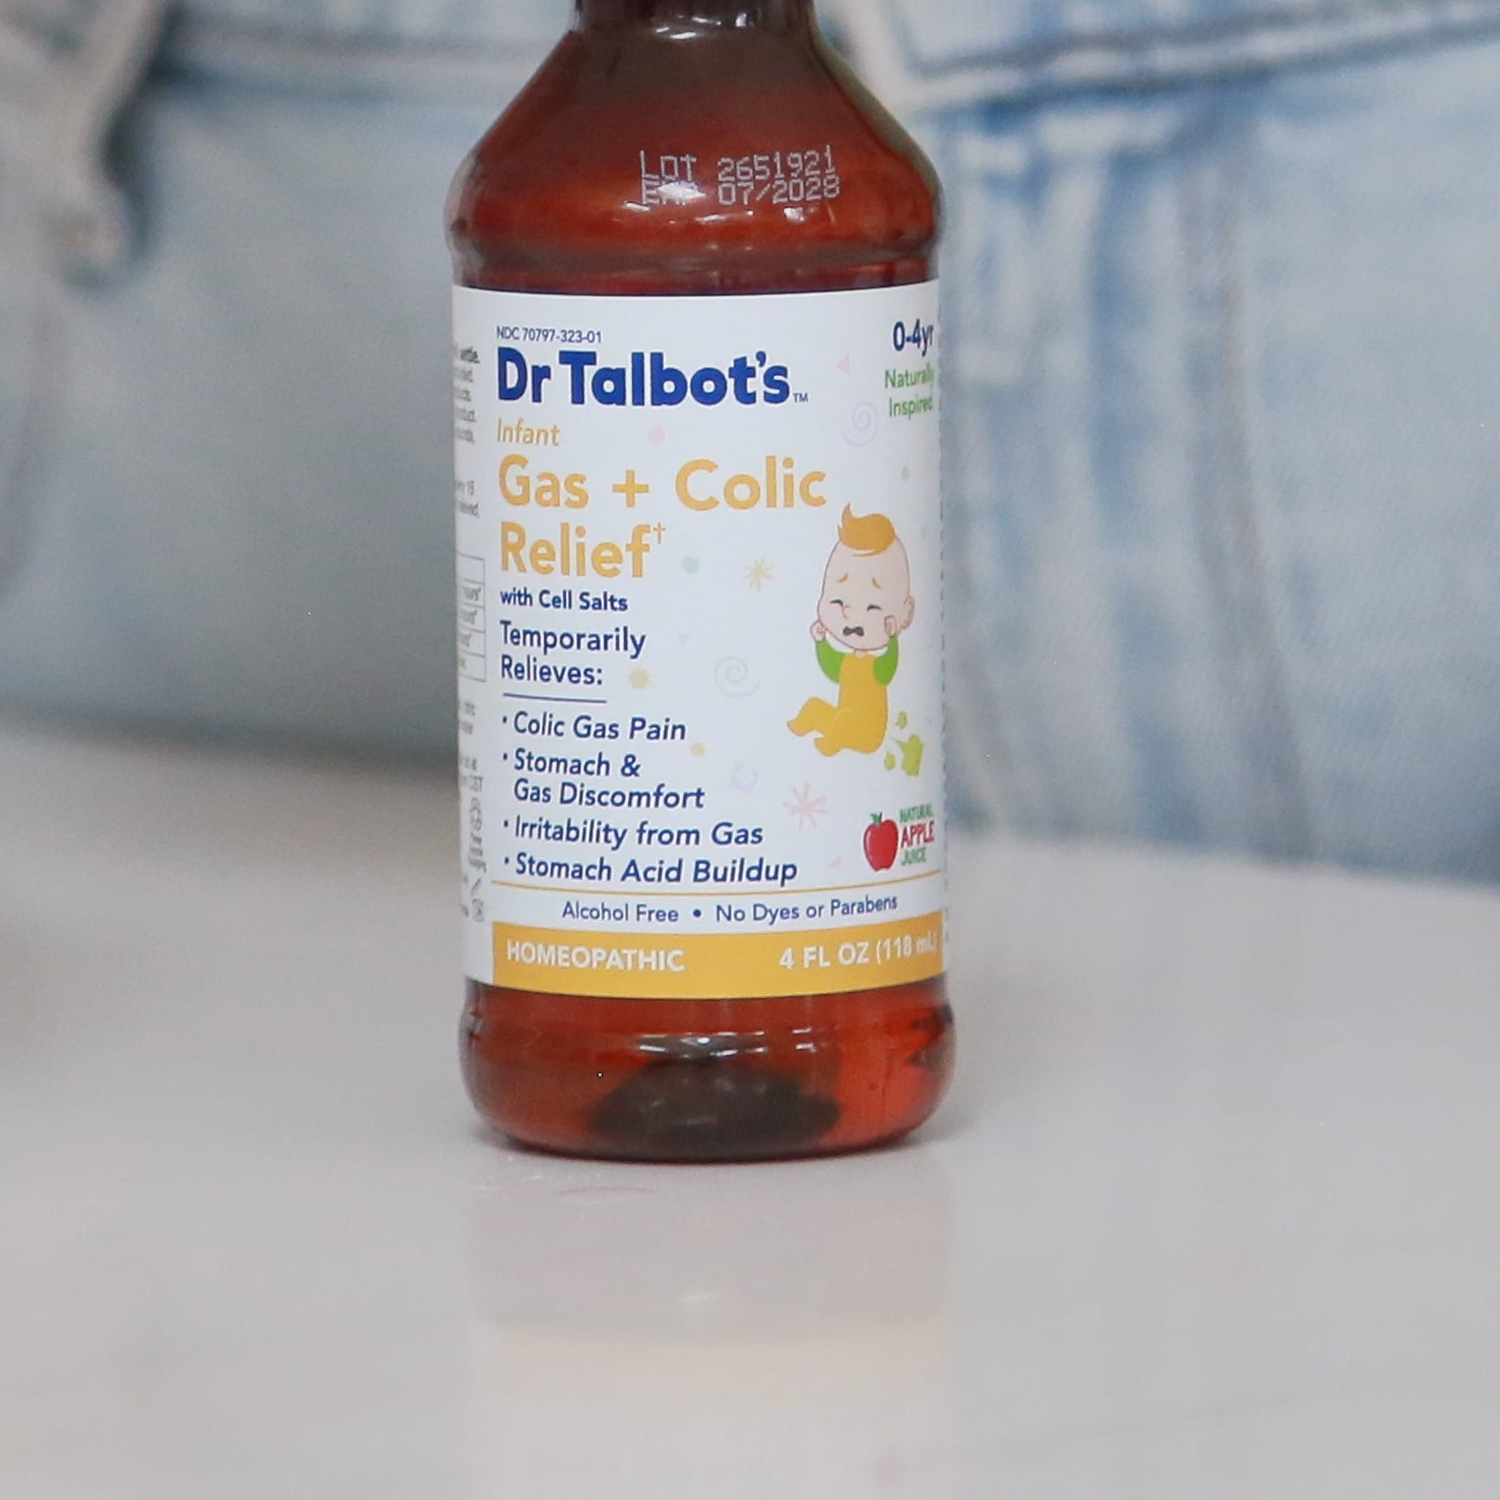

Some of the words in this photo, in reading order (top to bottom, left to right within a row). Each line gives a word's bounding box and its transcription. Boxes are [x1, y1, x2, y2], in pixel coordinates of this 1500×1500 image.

[640, 150, 697, 181] LOT
[717, 144, 836, 182] 2651921
[717, 173, 840, 205] 07/2028
[496, 325, 520, 341] NDC
[522, 327, 602, 344] 70797-323-01
[892, 318, 934, 358] 0-4yr
[497, 346, 552, 404] Dr
[496, 417, 561, 447] Infant
[498, 453, 590, 510] Gas
[611, 469, 650, 509] +
[674, 454, 828, 512] Colic
[499, 586, 534, 607] with
[538, 589, 573, 610] Cell
[578, 590, 628, 612] Salts
[499, 619, 646, 661] Temporarily
[501, 652, 603, 686] Relieves:
[513, 710, 565, 737] Colic
[572, 714, 620, 740] Gas
[629, 716, 686, 741] Pain
[513, 747, 611, 777] Stomach
[620, 753, 641, 778] &
[513, 777, 552, 804] Gas
[559, 781, 706, 809] Discomfort
[515, 814, 628, 852] Irritability
[635, 820, 701, 846] from
[711, 821, 763, 846] Gas
[900, 819, 935, 849] APPLE
[515, 851, 612, 882] Stomach
[620, 857, 684, 883] Acid
[692, 856, 798, 888] Buildup
[561, 900, 629, 922] Alcohol
[635, 903, 679, 923] Free
[716, 904, 746, 922] No
[752, 903, 800, 926] Dyes
[805, 904, 825, 919] or
[830, 894, 898, 917] Parabens
[507, 940, 686, 973] HOMEOPATHIC
[778, 947, 796, 970] 4
[803, 945, 832, 969] FL
[837, 941, 870, 966] OZ
[876, 935, 913, 964] (118
